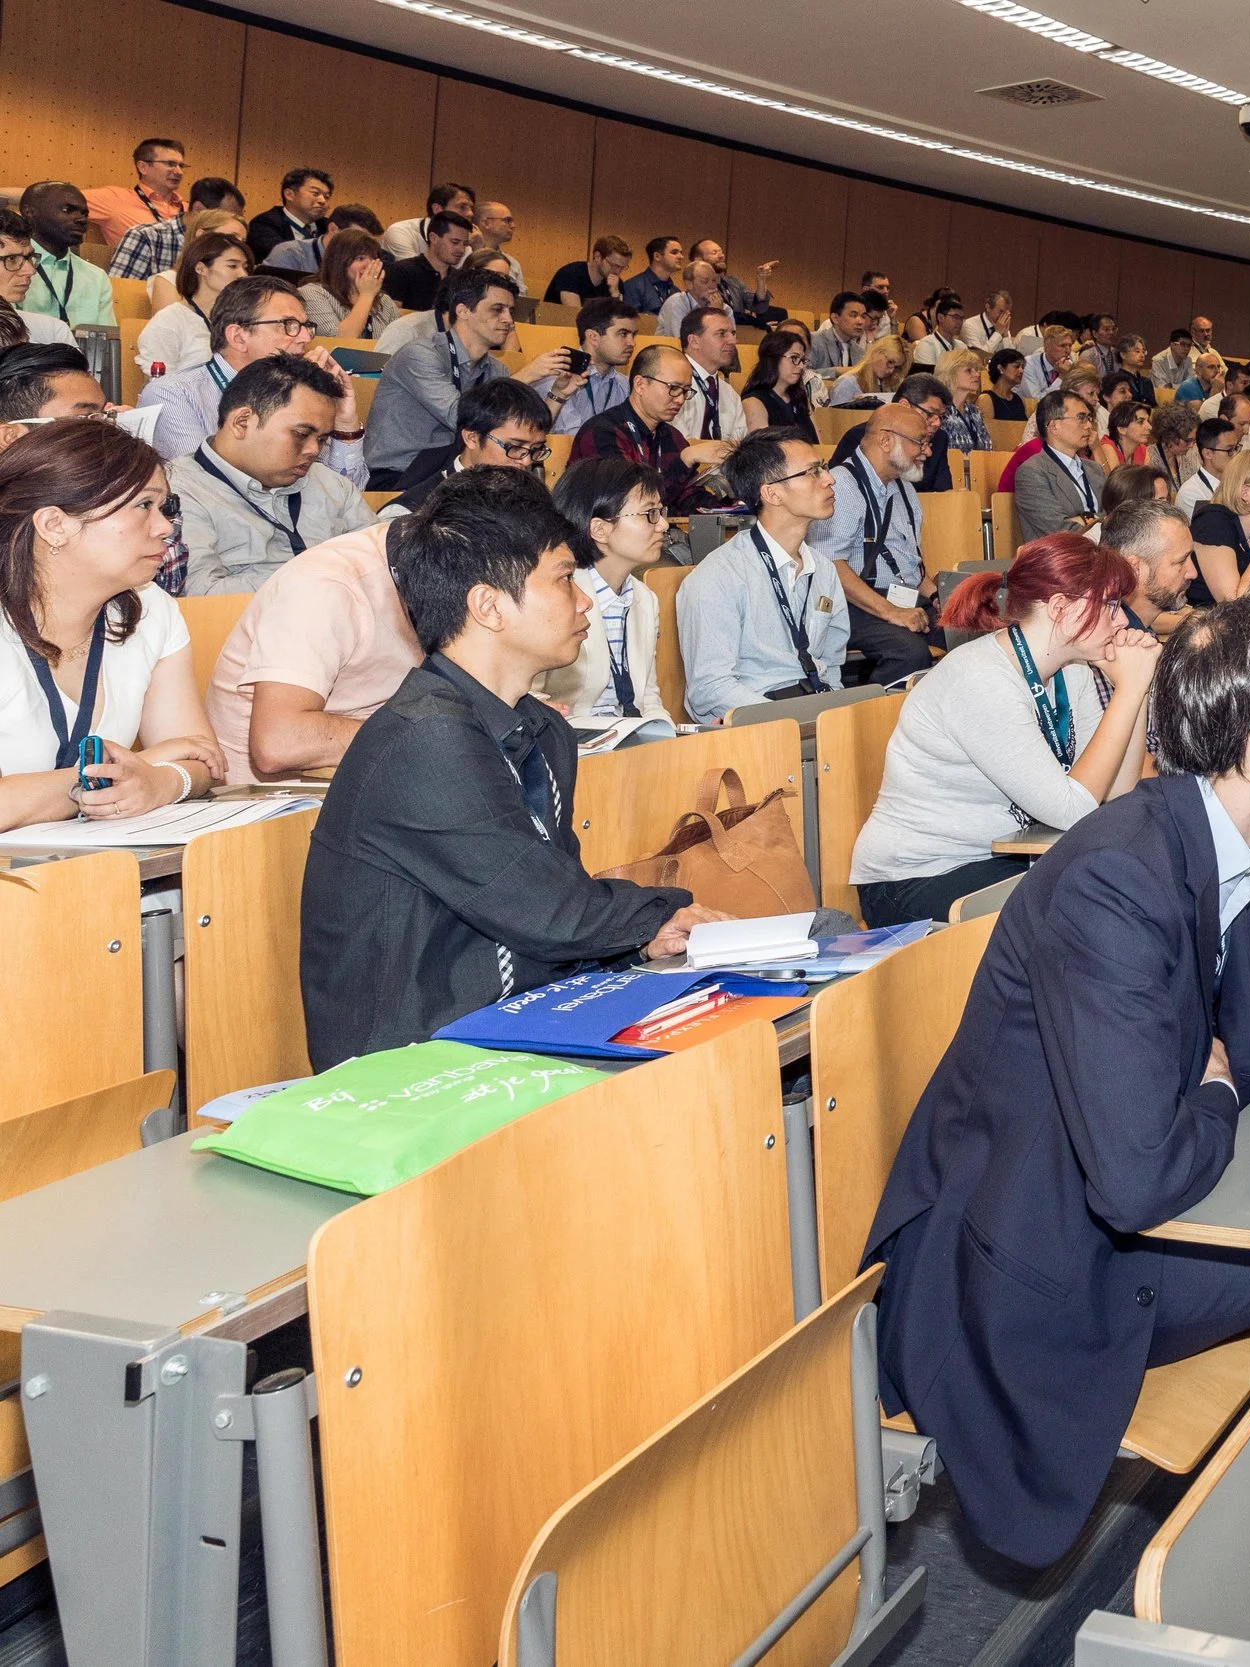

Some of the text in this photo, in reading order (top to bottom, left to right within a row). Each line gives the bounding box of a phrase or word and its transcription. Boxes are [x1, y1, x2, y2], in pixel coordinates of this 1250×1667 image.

[1020, 646, 1033, 675] Universiteit
[1049, 731, 1063, 757] Universiteit
[302, 1088, 356, 1112] Bij
[494, 1075, 526, 1102] je
